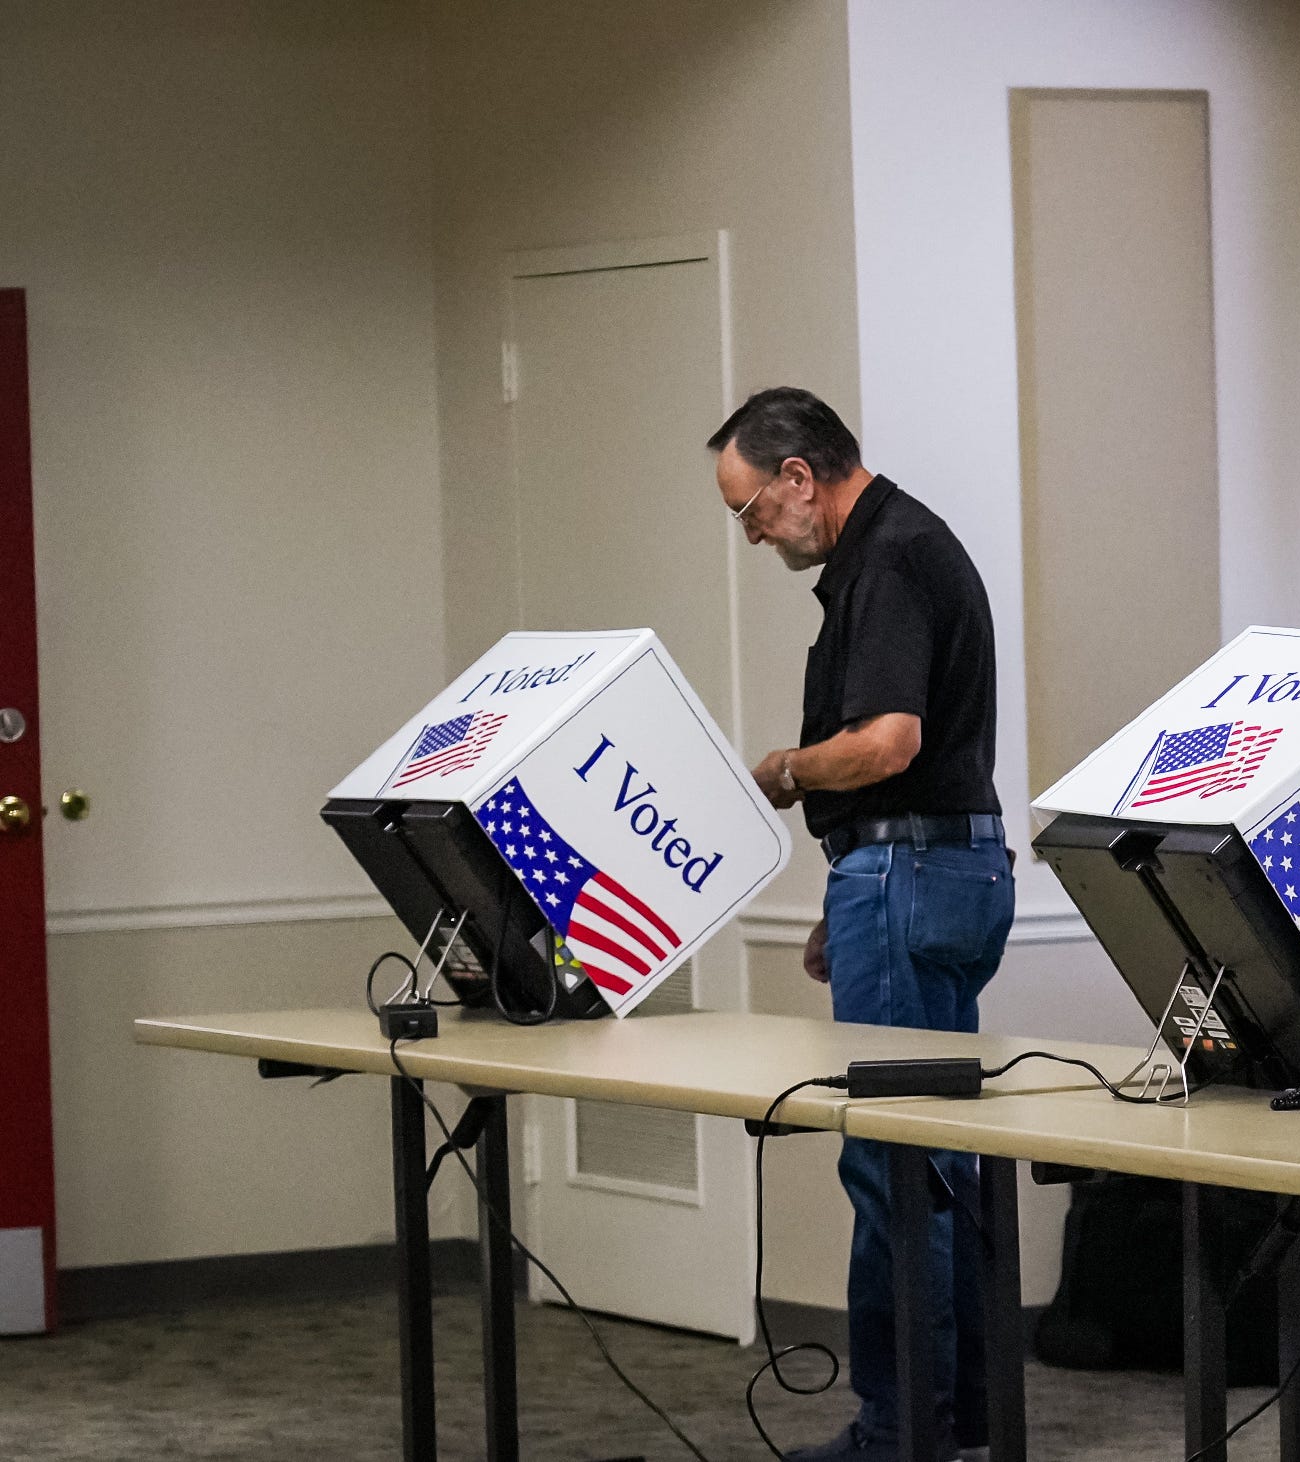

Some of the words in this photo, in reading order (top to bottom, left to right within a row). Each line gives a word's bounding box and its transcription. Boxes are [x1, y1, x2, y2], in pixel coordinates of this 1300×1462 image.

[457, 672, 491, 703] I
[489, 651, 597, 696] Voted!
[1200, 674, 1249, 709] I
[572, 734, 616, 783] I
[612, 760, 724, 894] Voted
